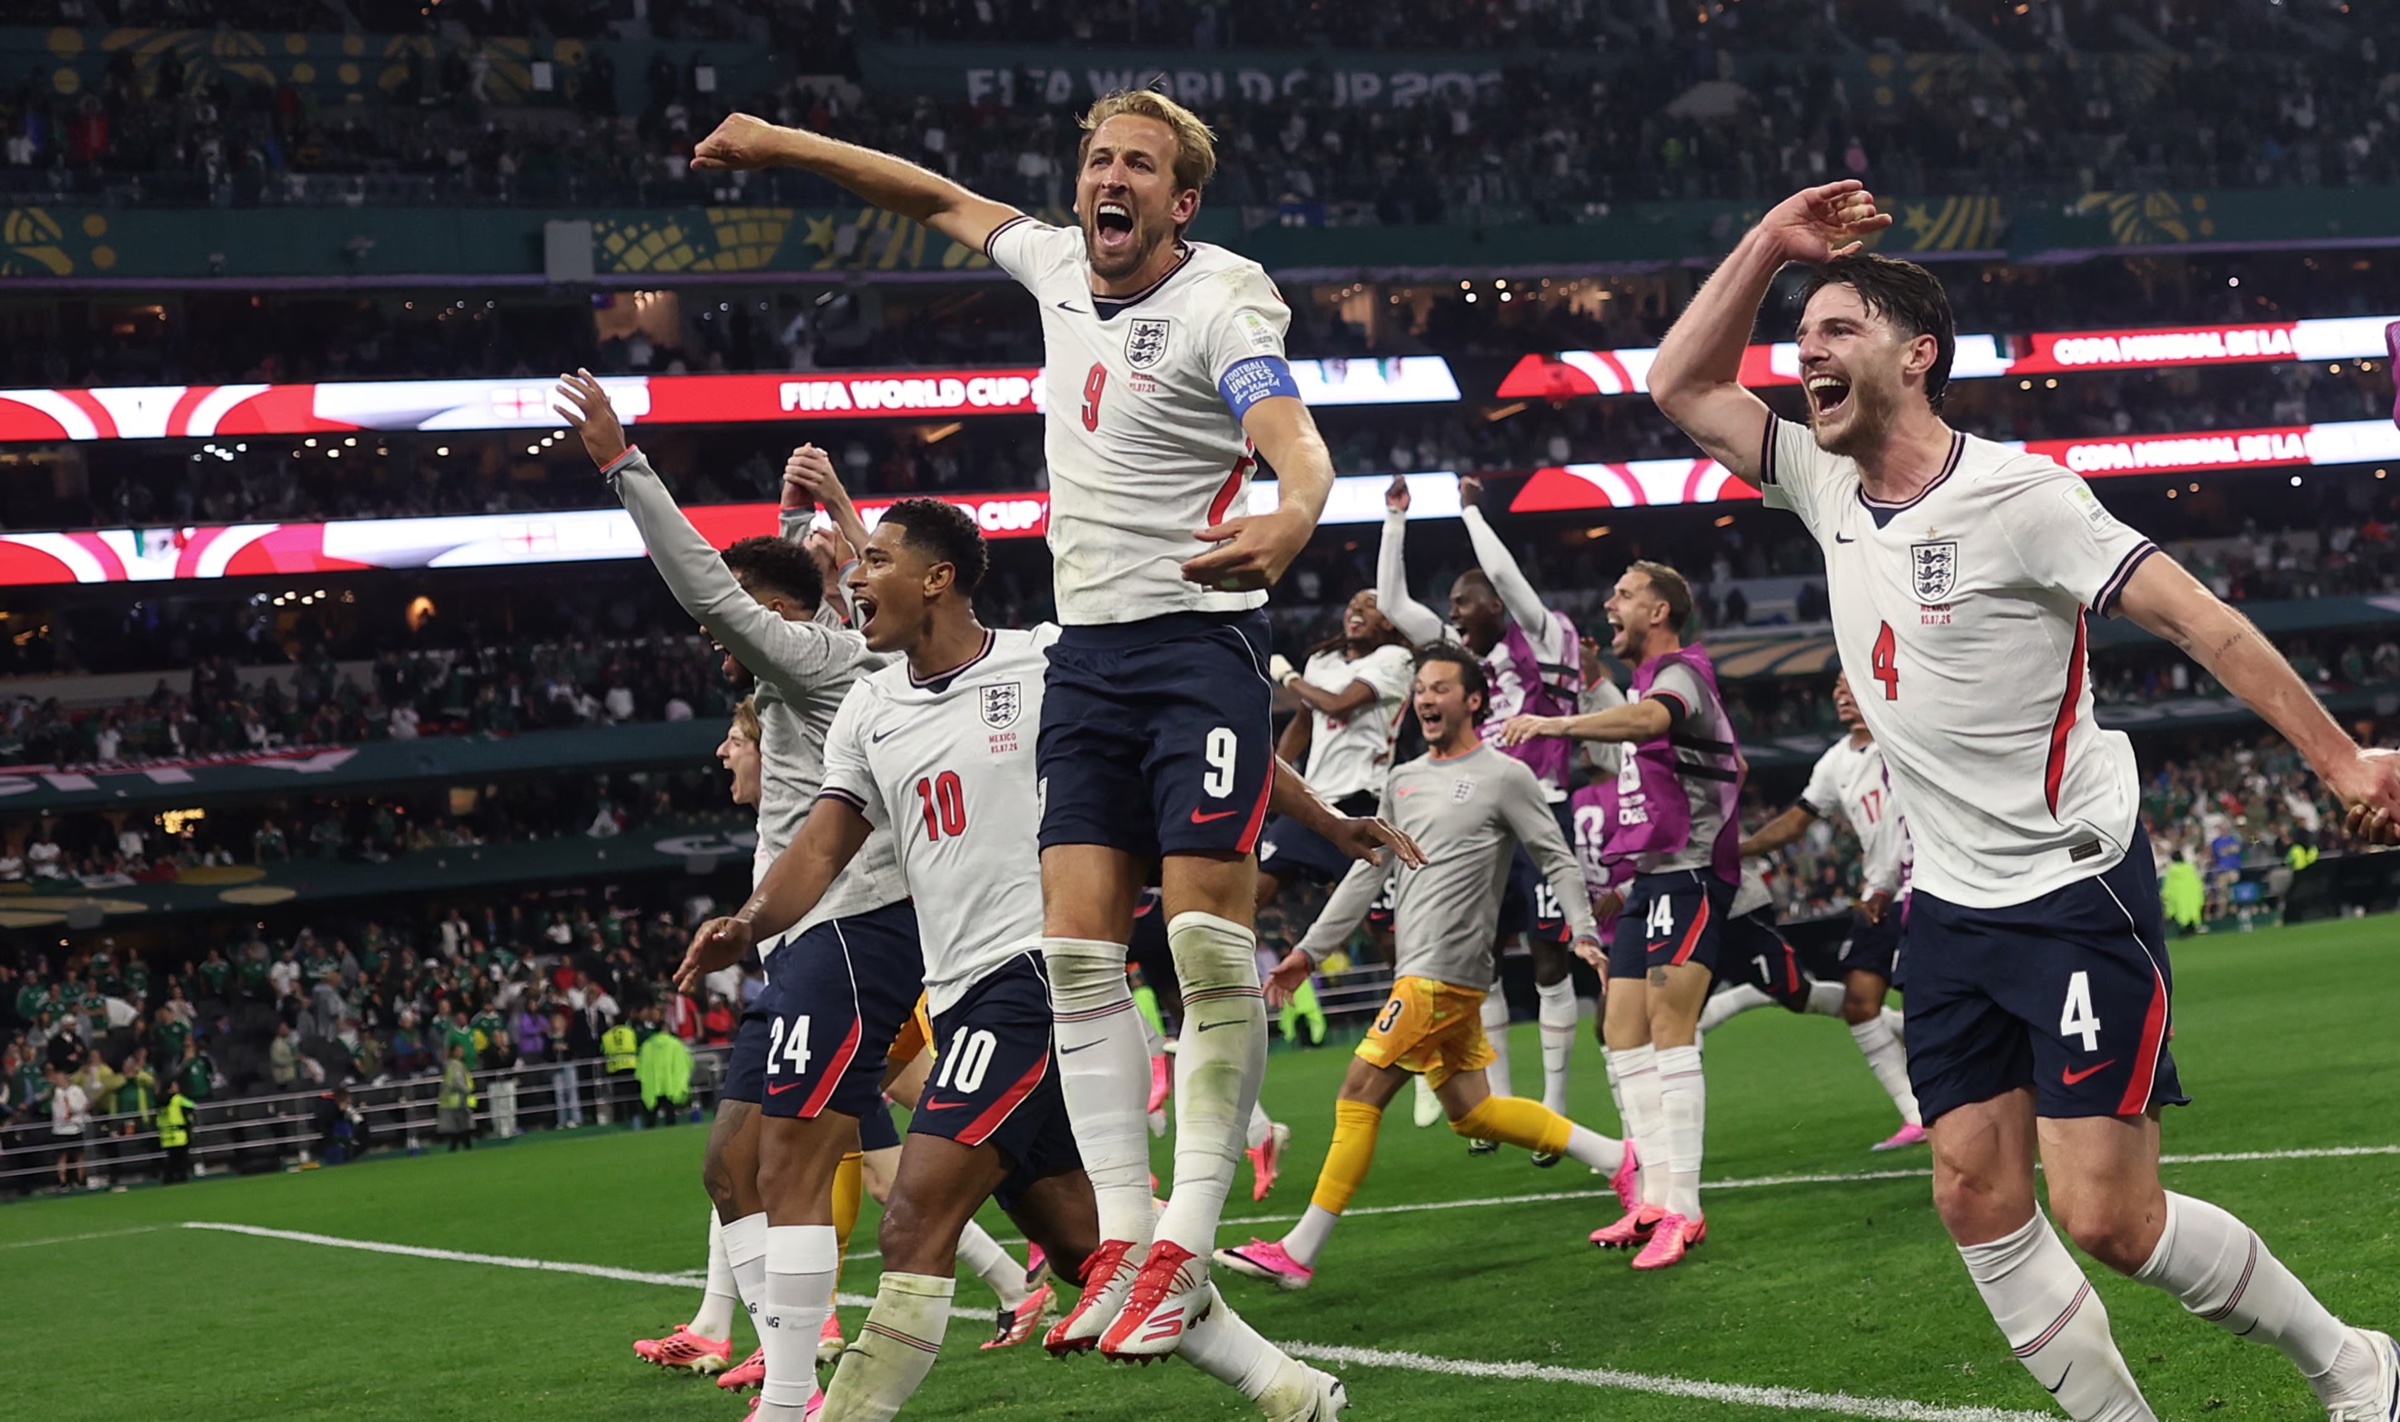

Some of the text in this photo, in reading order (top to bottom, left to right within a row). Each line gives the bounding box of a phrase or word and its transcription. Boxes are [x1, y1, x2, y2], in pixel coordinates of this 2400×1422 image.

[2054, 338, 2121, 365] COPA
[1224, 360, 1268, 385] FOOTBALL
[1229, 368, 1274, 394] UNITES
[1248, 378, 1280, 392] World
[780, 382, 852, 411] FIFA
[850, 379, 966, 409] WORLD
[966, 377, 1030, 406] CUP
[1081, 361, 1107, 433] 9
[2067, 444, 2133, 471] COPA
[978, 501, 1042, 531] CUP
[1871, 619, 1899, 701] 4
[989, 733, 1016, 743] MEXICO
[991, 743, 1018, 754] 05.07.26
[1203, 726, 1237, 799] 9
[916, 770, 966, 841] 10
[1860, 789, 1881, 824] 17
[1534, 884, 1562, 918] 12
[1646, 894, 1674, 938] 14
[1379, 1000, 1402, 1032] 3
[2060, 971, 2101, 1052] 4
[767, 1015, 811, 1074] 24
[936, 1026, 997, 1094] 10
